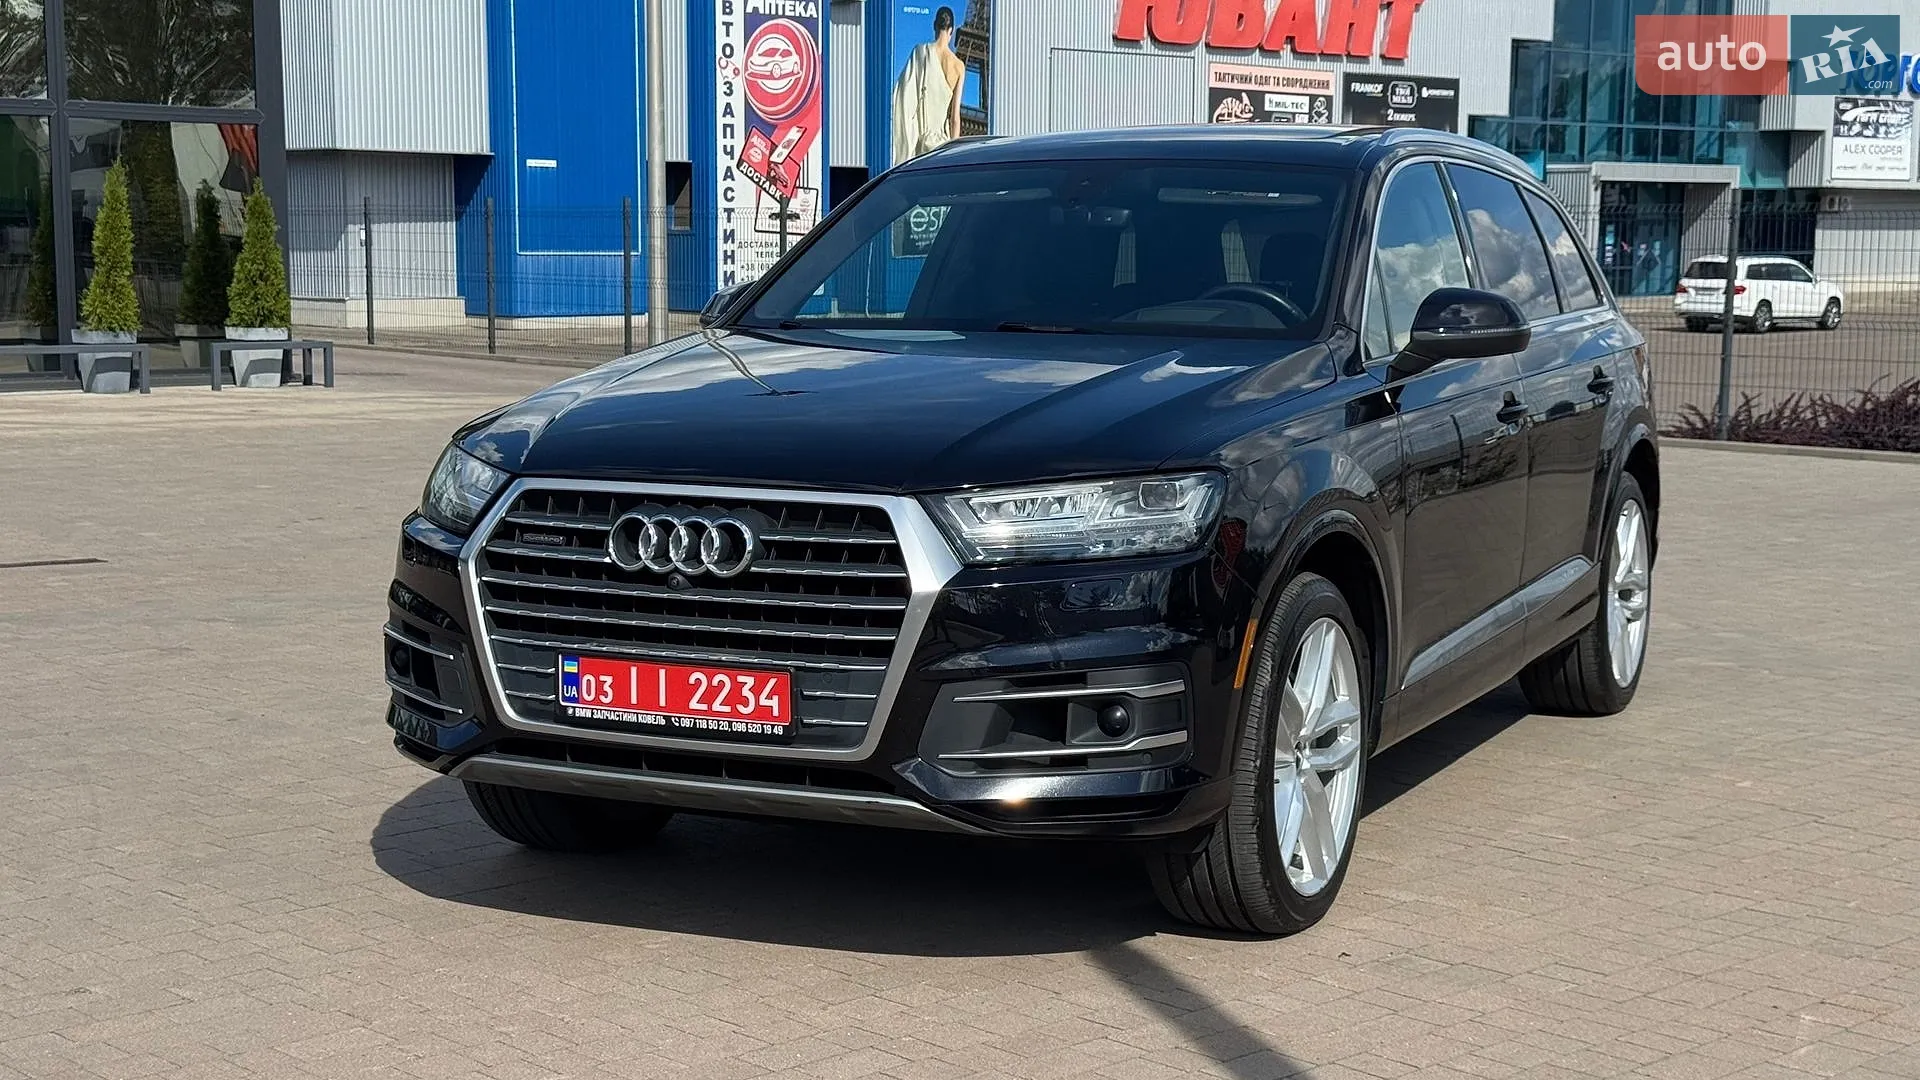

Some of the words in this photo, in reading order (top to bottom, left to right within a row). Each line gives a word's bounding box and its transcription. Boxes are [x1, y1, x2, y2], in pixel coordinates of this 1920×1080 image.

[1214, 71, 1252, 84] ТАКТИЧНИЙ
[1254, 75, 1272, 86] ОДЯГ
[1273, 76, 1280, 87] ТА
[1387, 108, 1394, 121] 2
[1843, 143, 1866, 153] ALEX
[1868, 144, 1903, 155] COOPER
[563, 684, 578, 698] UA
[581, 673, 614, 704] 03
[688, 671, 779, 717] 2234
[575, 707, 592, 718] BMW
[592, 709, 637, 722] ЗАПЧАСТИНИ
[638, 714, 666, 725] КОВЕЛЬ
[680, 718, 694, 727] 097
[695, 719, 707, 729] 118
[708, 720, 718, 730] 50
[732, 722, 747, 732] 096
[748, 723, 762, 733] 520
[763, 725, 772, 734] 19
[772, 726, 784, 735] 49
